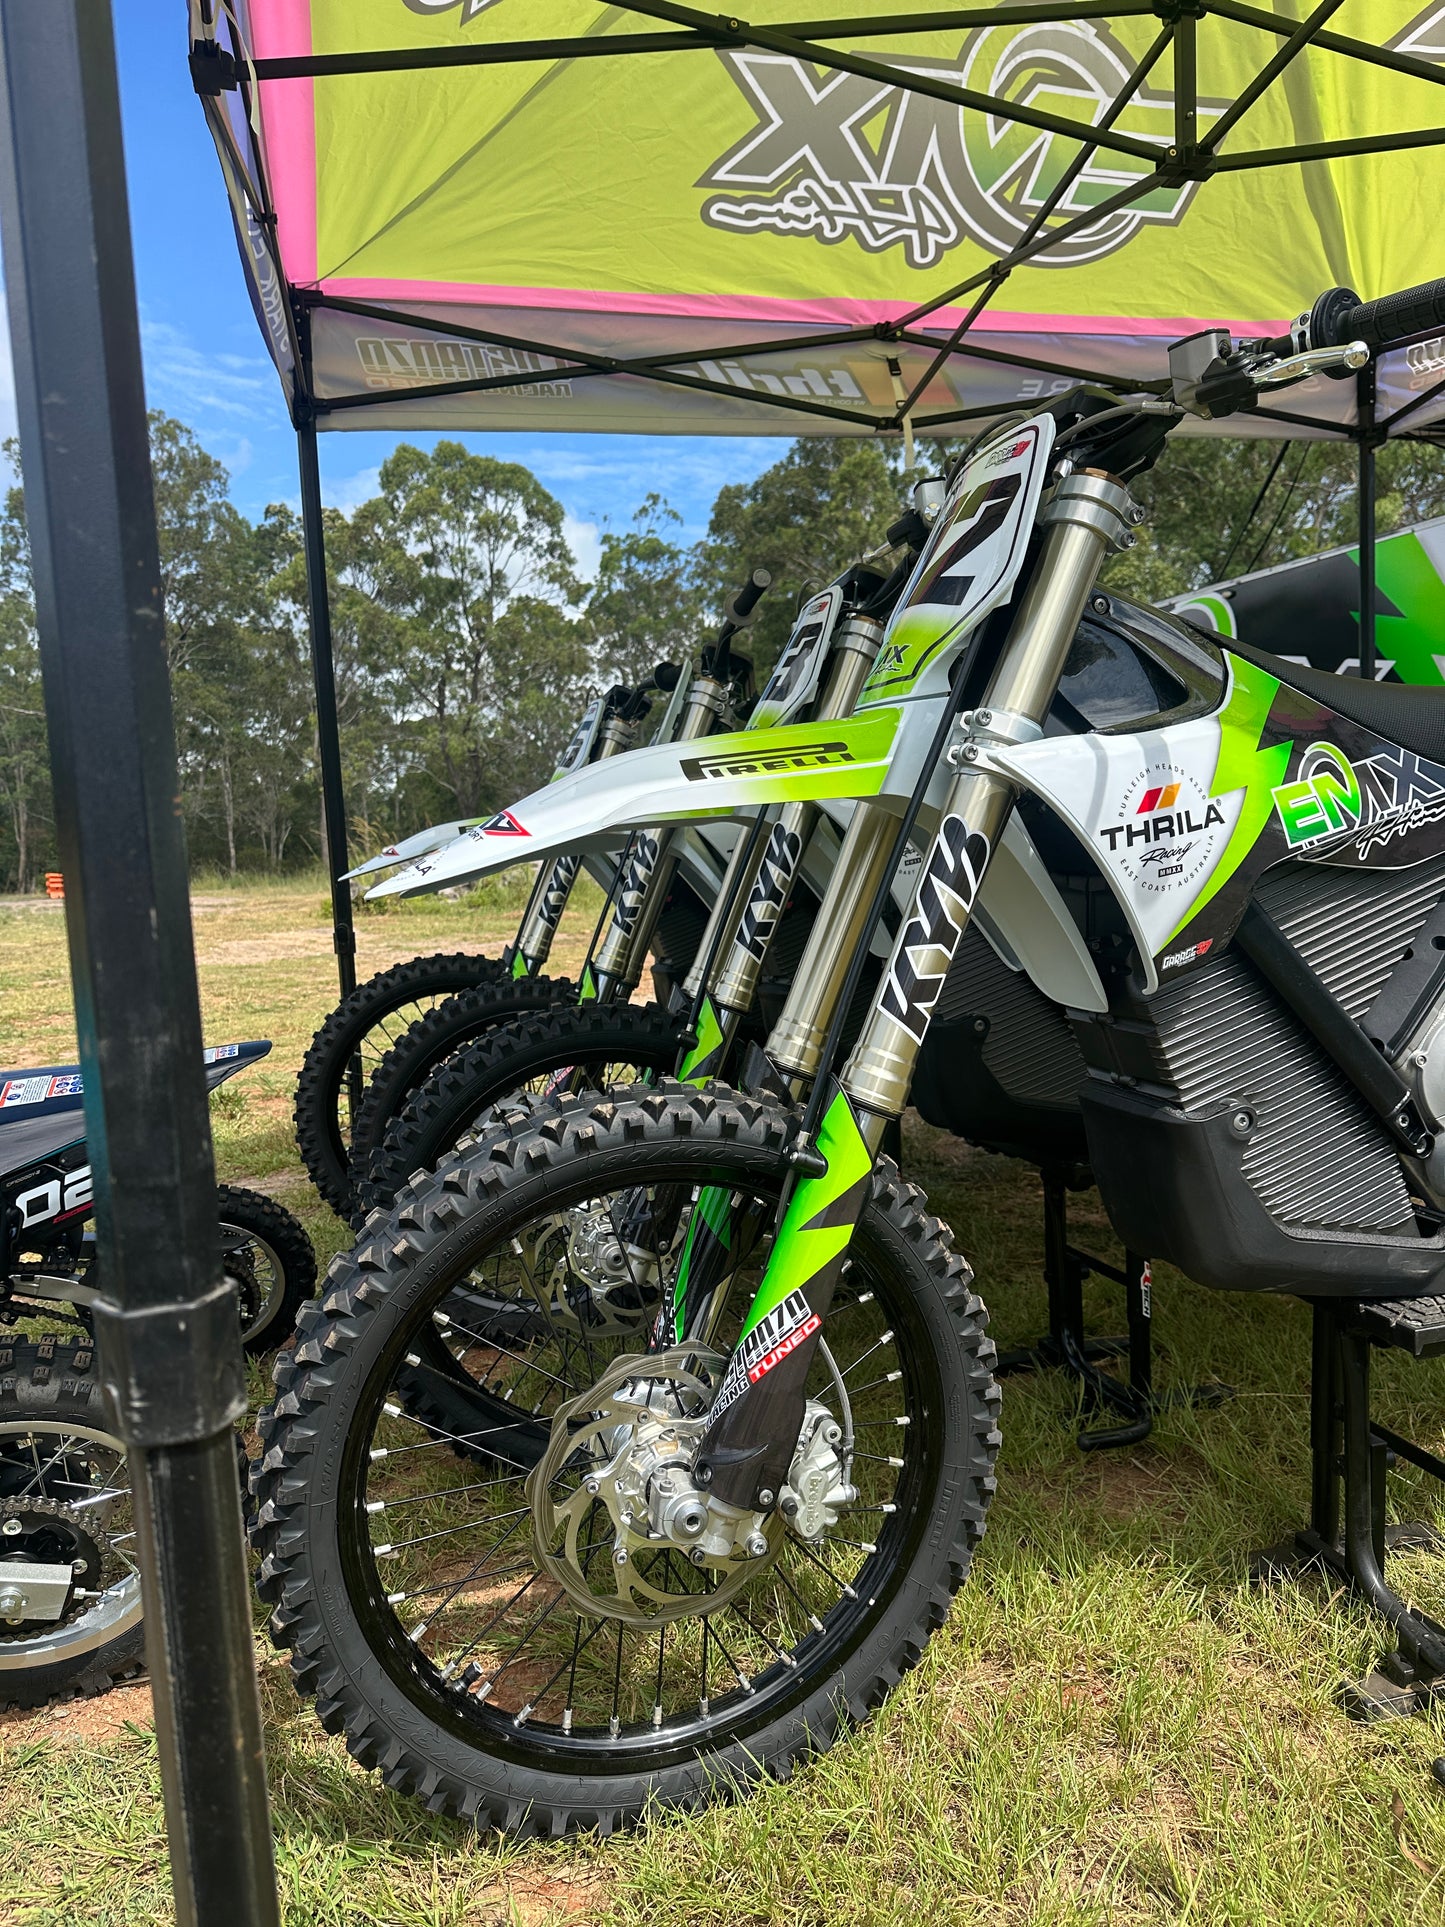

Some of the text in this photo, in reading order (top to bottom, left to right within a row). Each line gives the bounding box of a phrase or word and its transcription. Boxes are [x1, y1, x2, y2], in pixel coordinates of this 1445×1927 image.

[679, 741, 857, 782] PIRELLI
[1118, 767, 1151, 818] BURLEIGH
[1154, 762, 1185, 776] HEADS
[1100, 803, 1226, 851] THRILA
[1120, 834, 1215, 892] EAST COAST AUSTRALIA
[1139, 839, 1202, 868] Racing
[750, 1315, 821, 1381] TUNED
